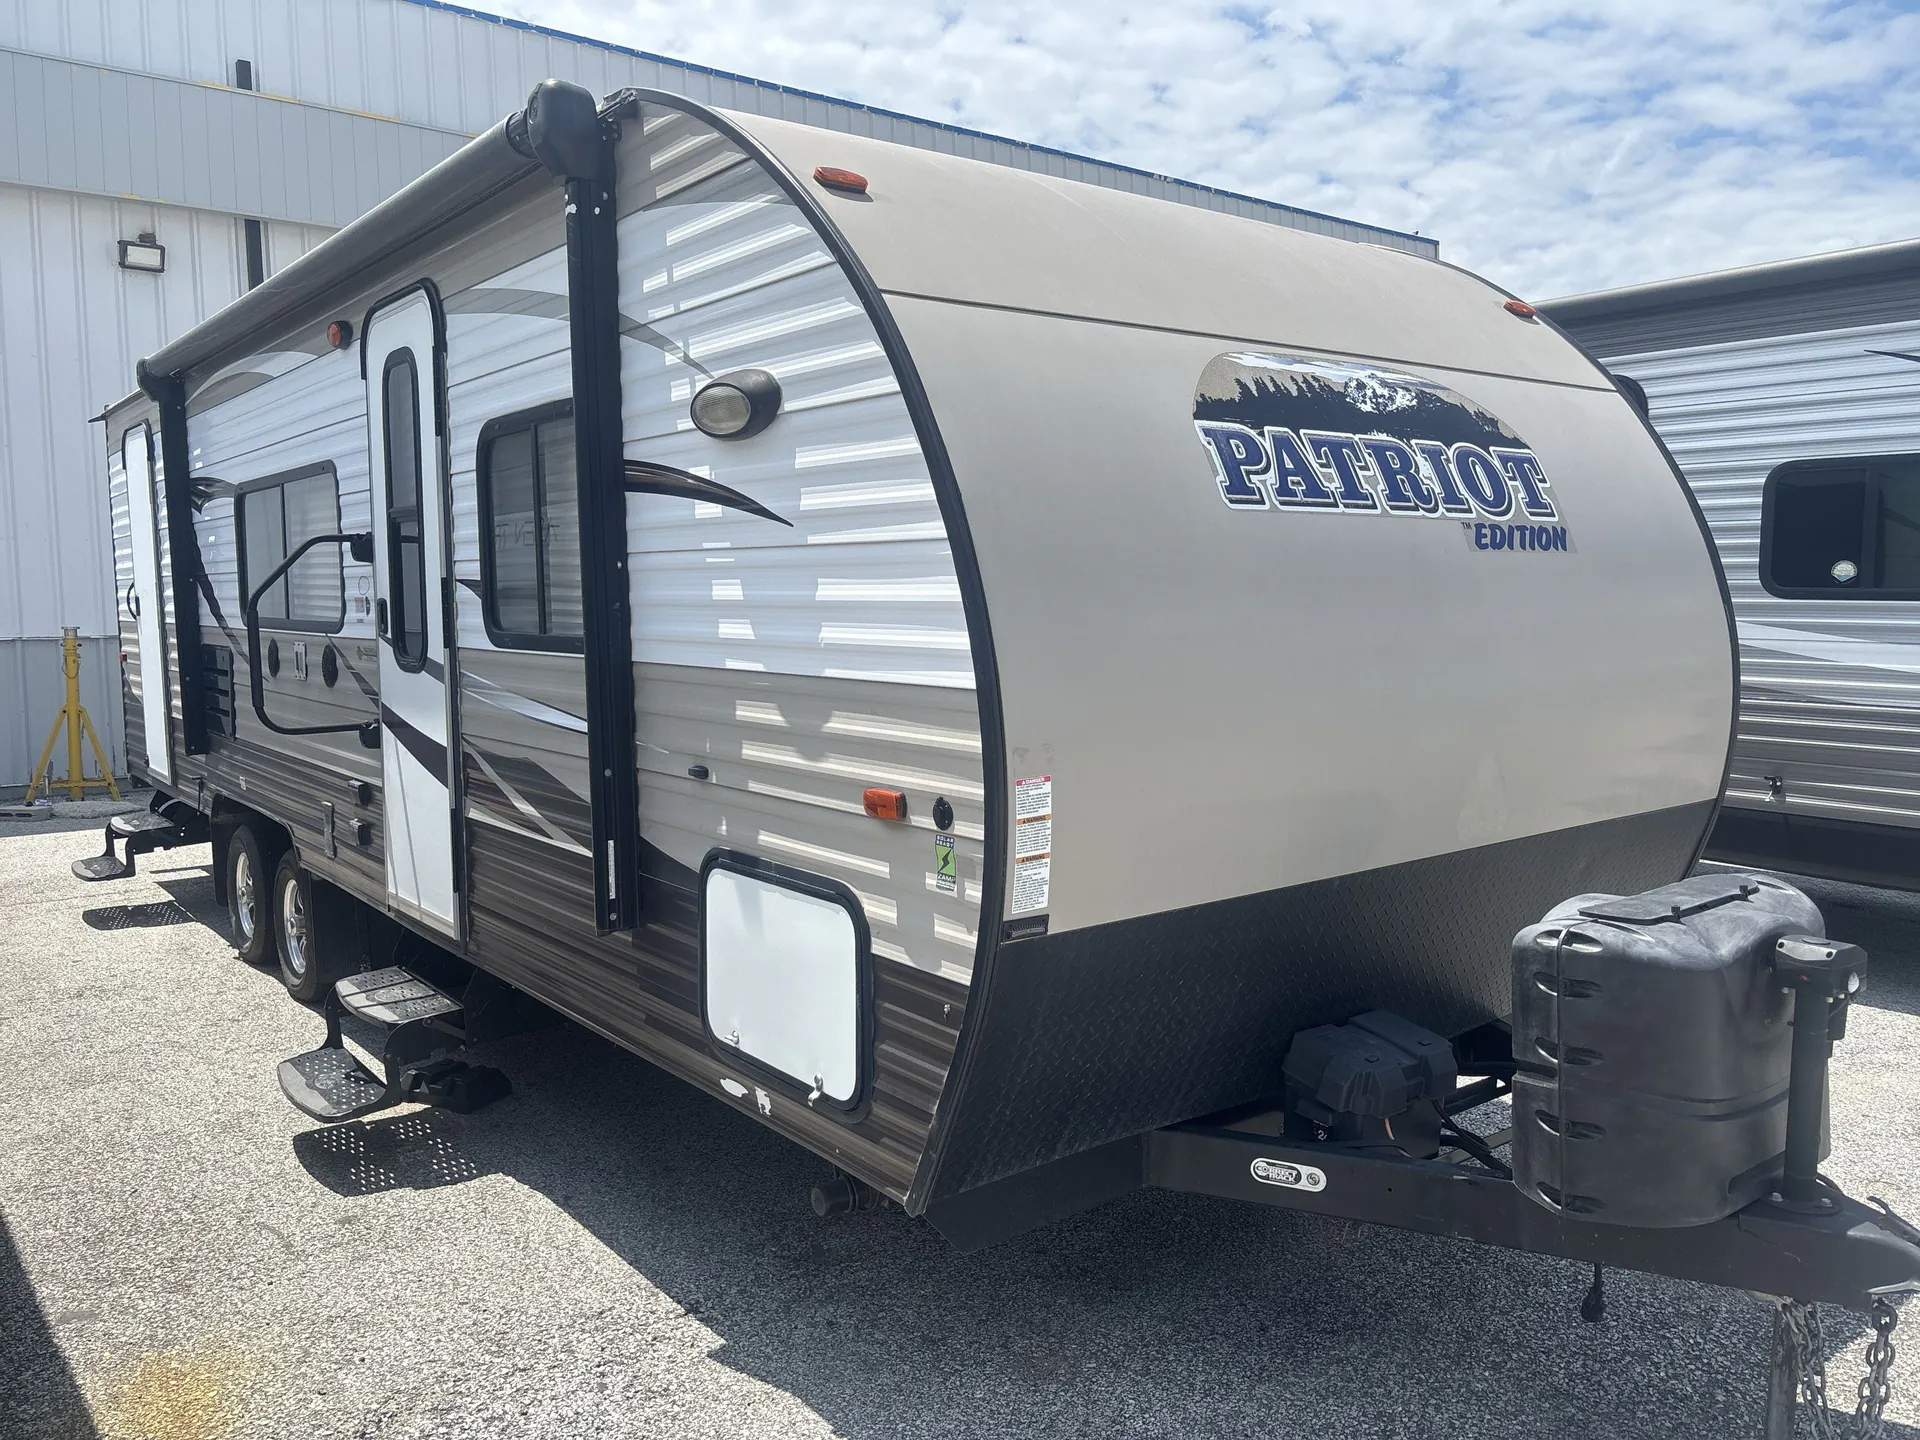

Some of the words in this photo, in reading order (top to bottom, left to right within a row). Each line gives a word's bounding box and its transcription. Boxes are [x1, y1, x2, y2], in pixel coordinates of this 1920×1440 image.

[1197, 422, 1559, 520] PATRIOT
[1474, 522, 1567, 552] EDITION
[1026, 815, 1046, 823] WARNING
[936, 835, 954, 843] SOLAR
[936, 840, 954, 848] READY
[1025, 854, 1045, 862] WARNING
[938, 873, 956, 882] ZAMP
[1255, 1164, 1298, 1179] CORRECT
[1269, 1173, 1296, 1183] TRACK
